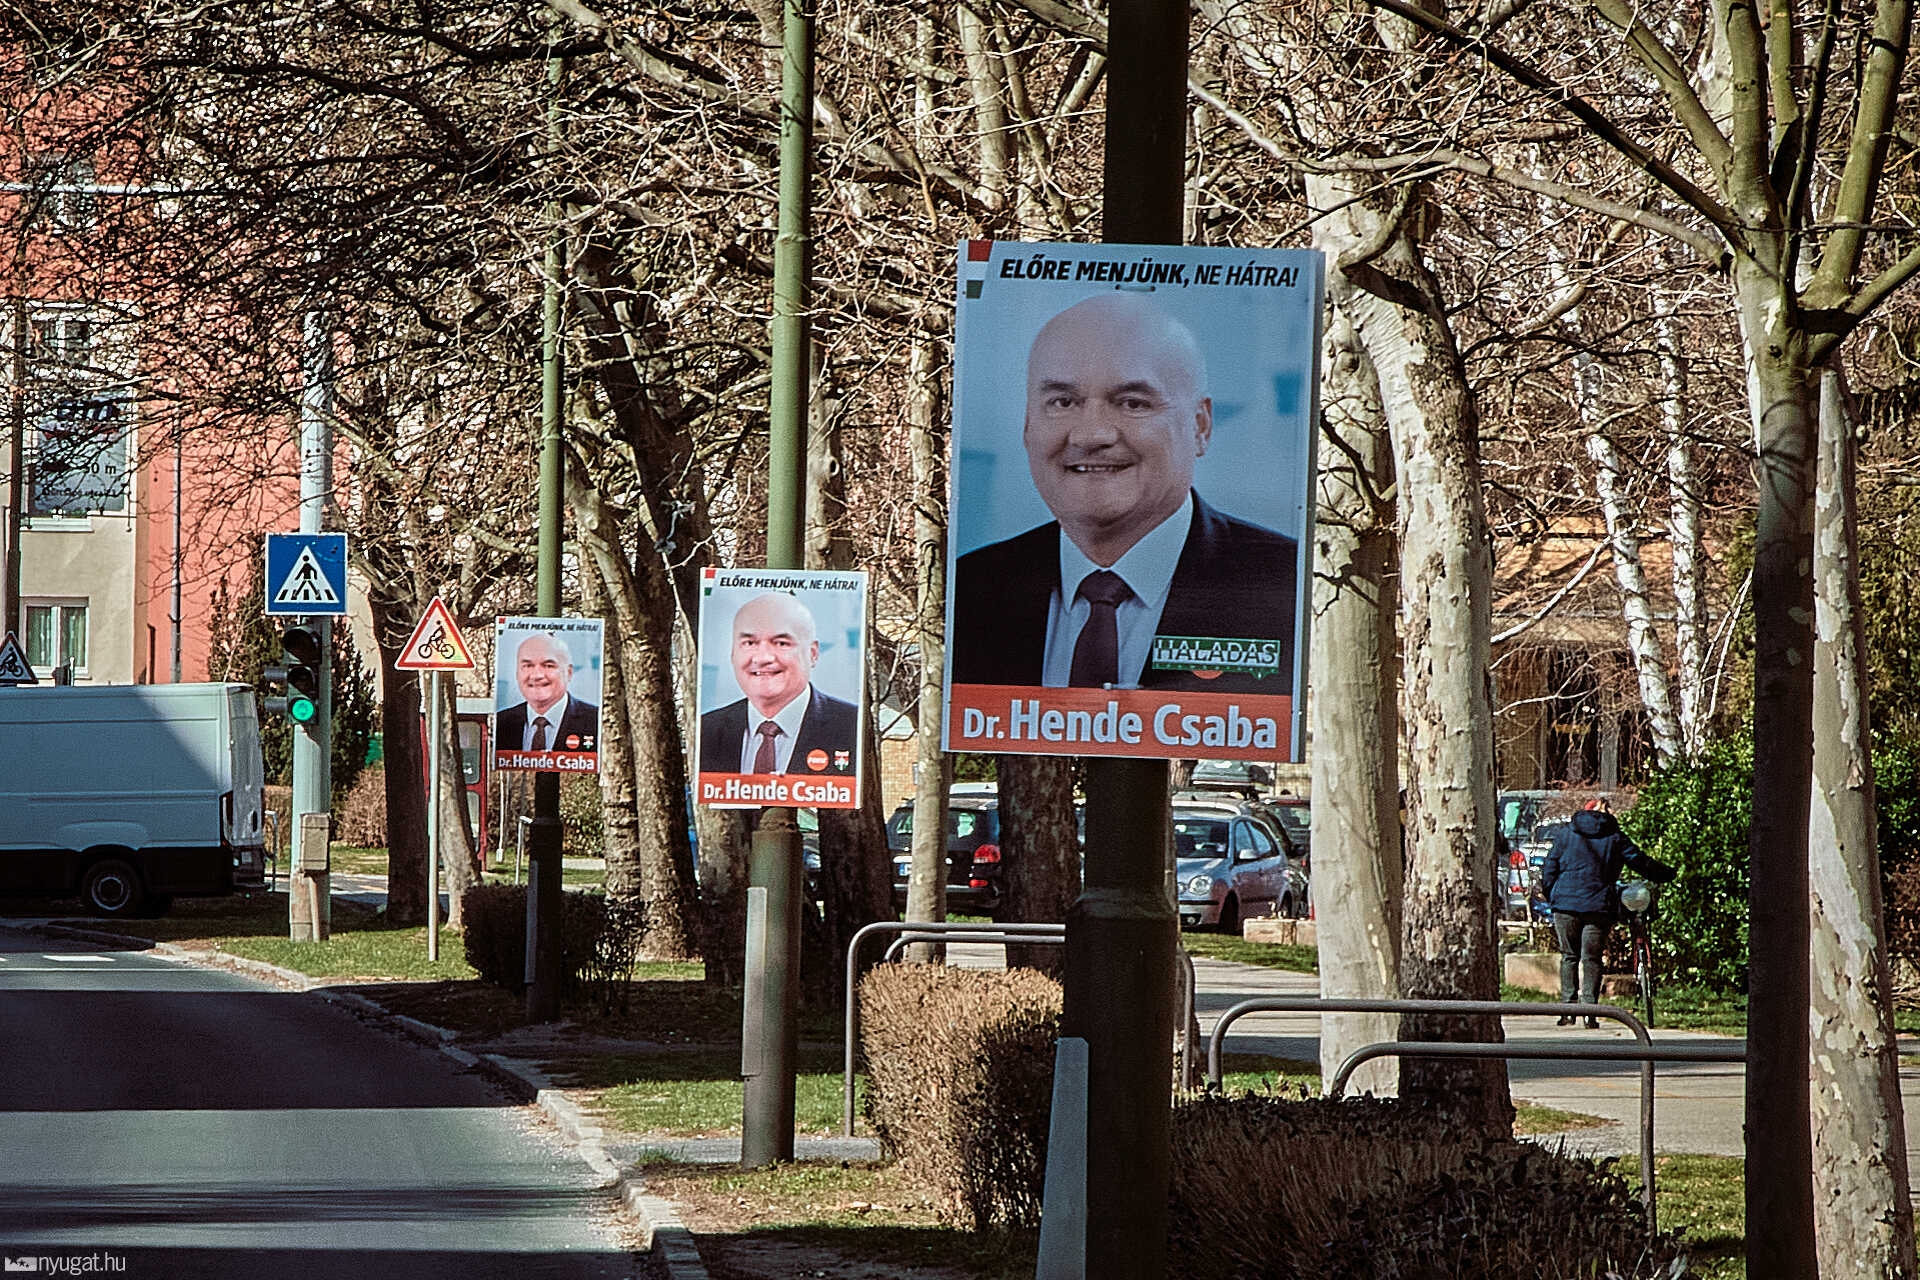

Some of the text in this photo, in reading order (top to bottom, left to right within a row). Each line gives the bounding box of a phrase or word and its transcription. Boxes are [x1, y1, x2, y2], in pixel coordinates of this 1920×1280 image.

[1000, 253, 1299, 288] ELŐRE MENJÜNK, NE HÁTRA!
[719, 574, 858, 591] ELŐRE MENJÜNK, NE HÁTRA!
[1153, 703, 1277, 749] Csaba
[556, 754, 595, 770] Csaba
[792, 781, 851, 803] Csaba
